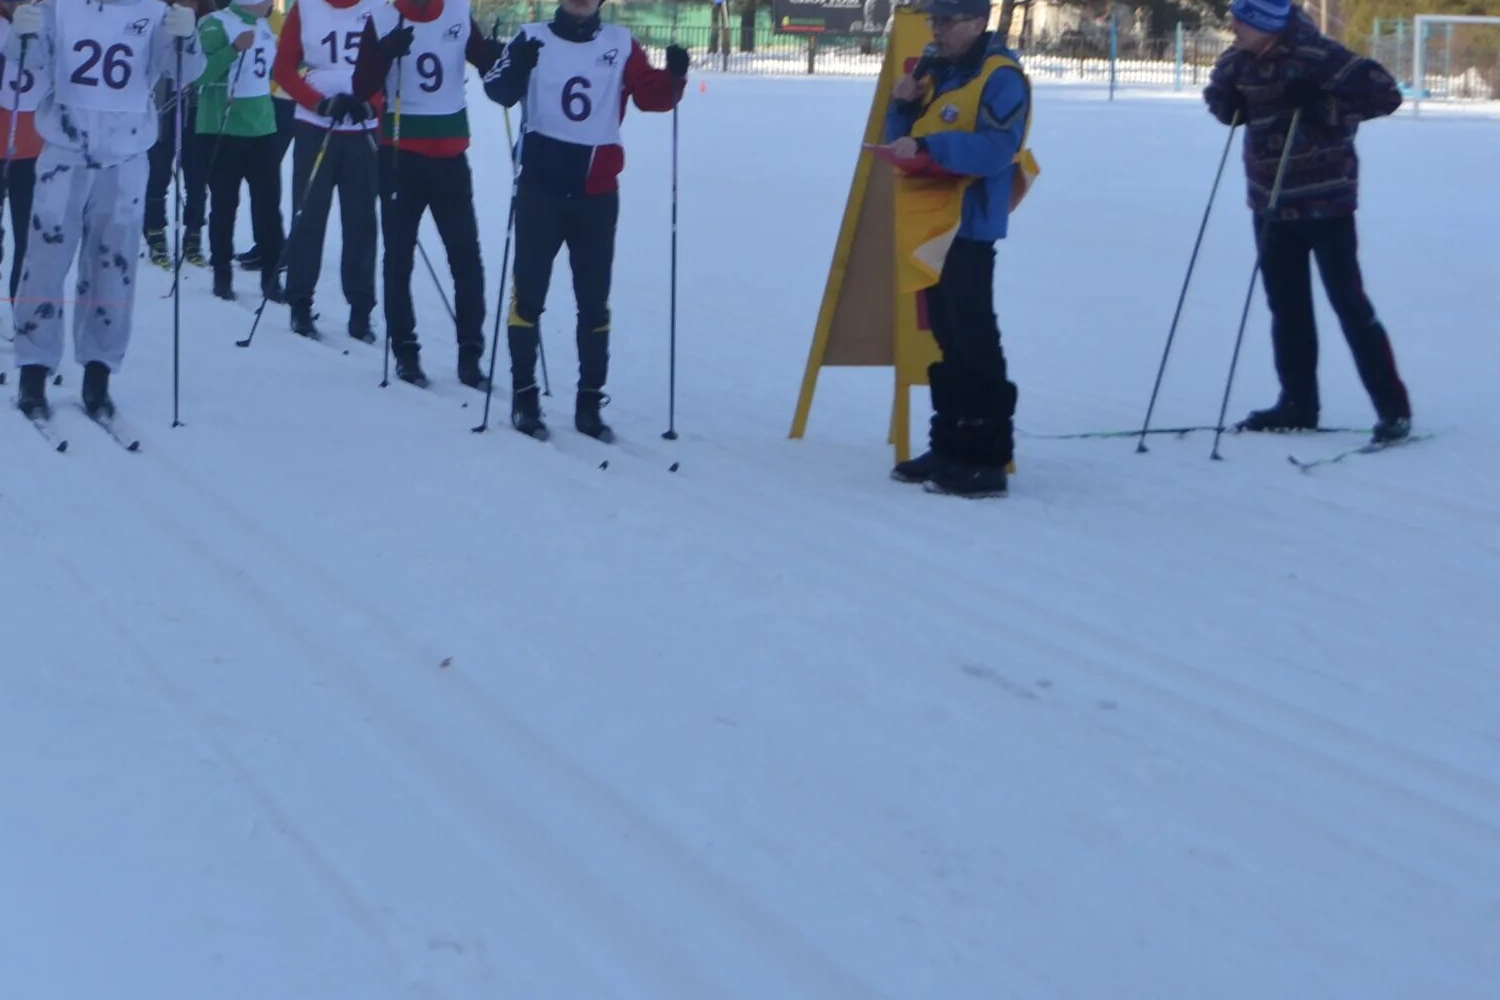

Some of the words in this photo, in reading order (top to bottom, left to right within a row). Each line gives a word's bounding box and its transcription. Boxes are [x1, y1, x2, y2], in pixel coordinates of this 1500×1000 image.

[70, 39, 134, 90] 26
[321, 30, 363, 65] 15
[416, 52, 443, 92] 9
[561, 76, 592, 121] 6
